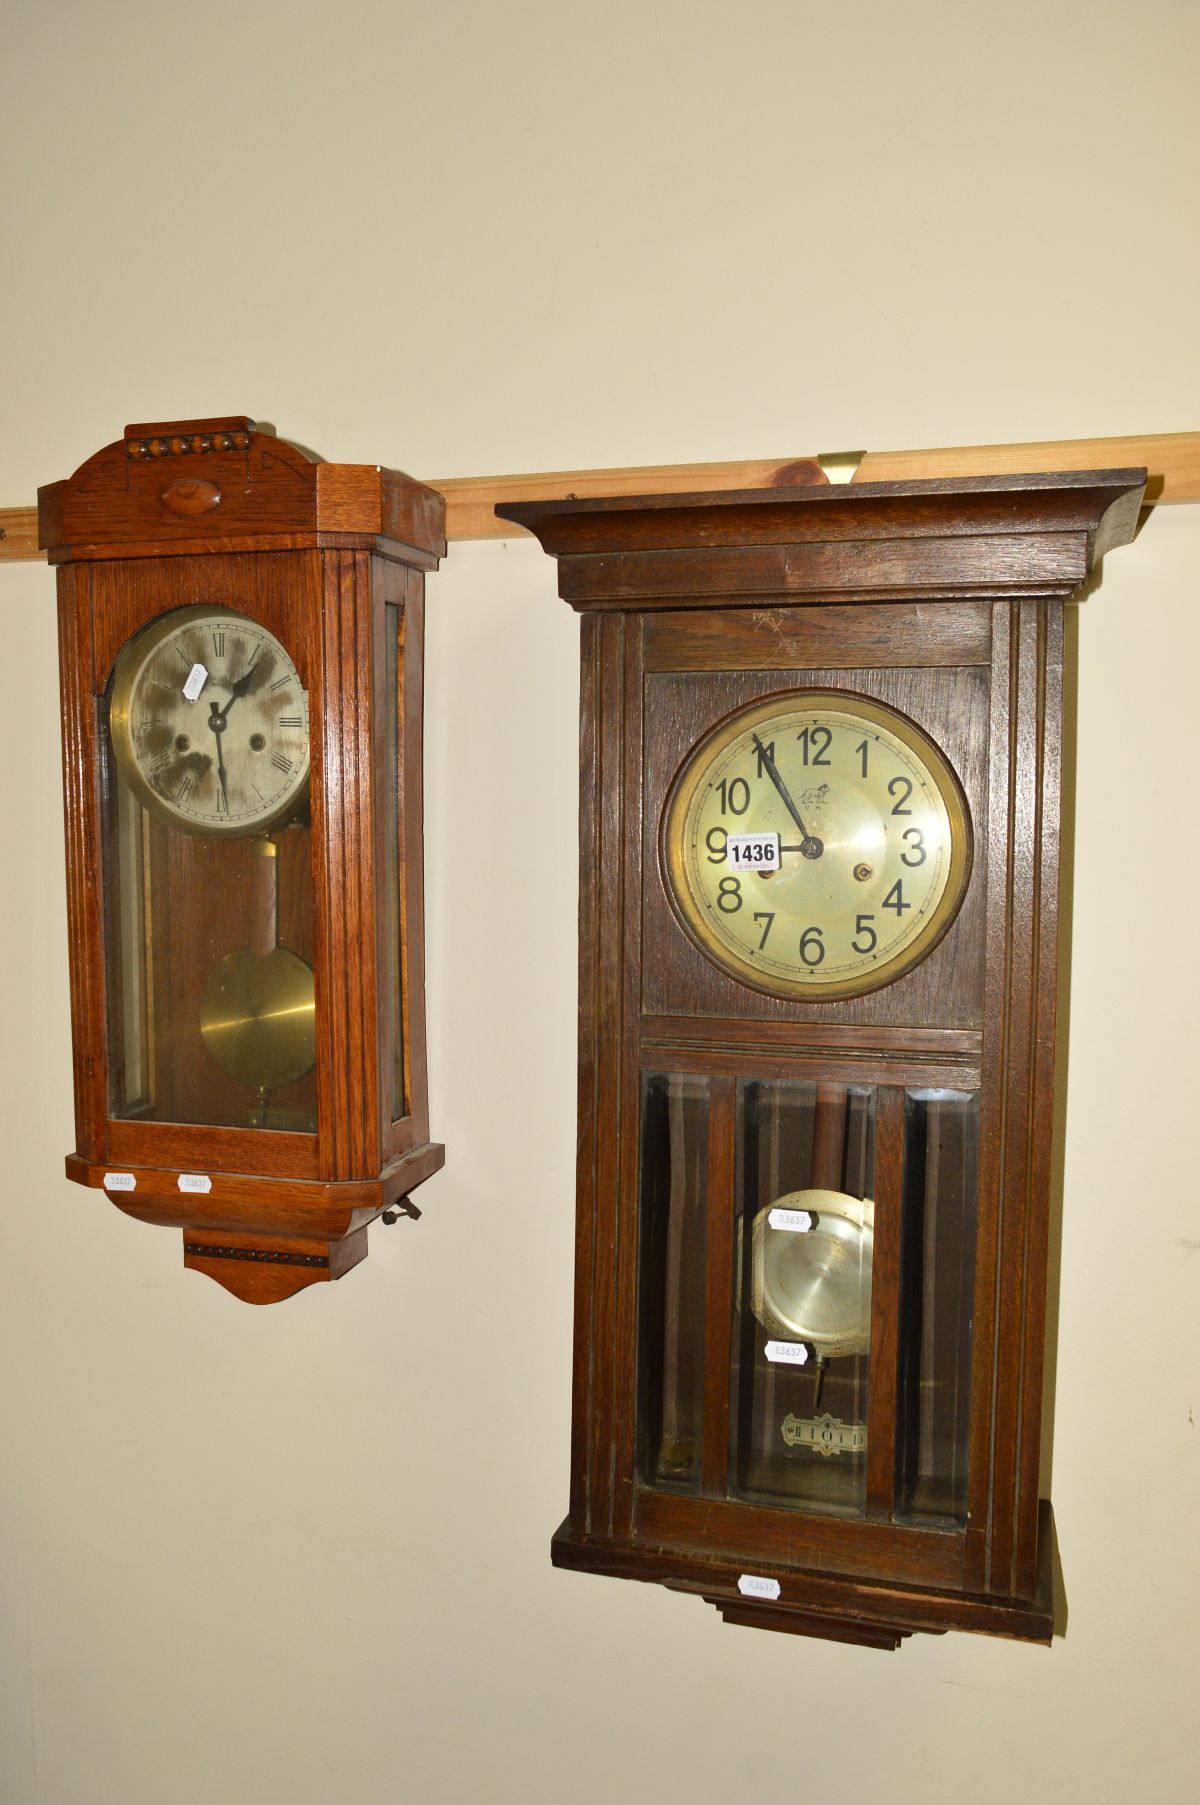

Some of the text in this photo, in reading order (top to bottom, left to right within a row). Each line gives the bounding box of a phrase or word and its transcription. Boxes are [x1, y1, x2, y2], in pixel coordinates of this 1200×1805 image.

[279, 717, 302, 728] III
[797, 726, 833, 766] 12
[855, 740, 868, 778] 1
[715, 777, 750, 815] 10
[887, 777, 913, 815] 2
[705, 826, 728, 864] 9
[732, 843, 775, 862] 1436
[900, 828, 927, 867] 3
[717, 876, 743, 913] 8
[882, 879, 911, 917] 4
[753, 912, 775, 950] 7
[799, 927, 825, 966] 6
[851, 914, 877, 954] 5
[775, 1346, 801, 1357] R3637
